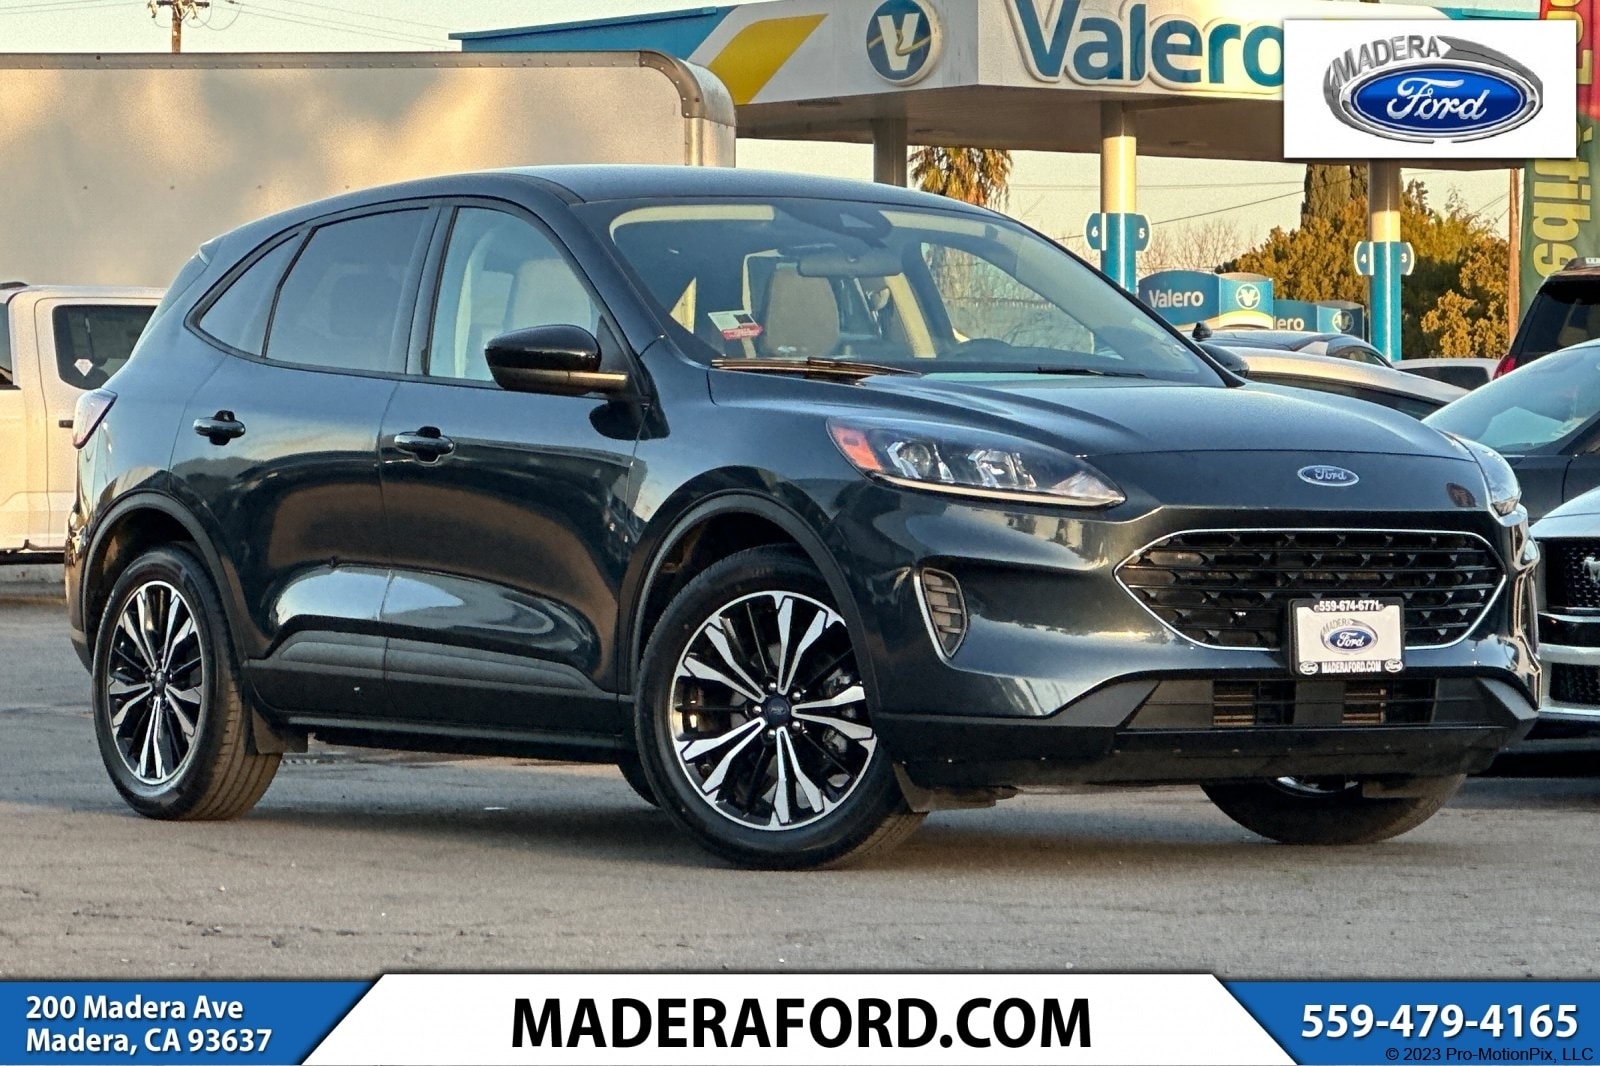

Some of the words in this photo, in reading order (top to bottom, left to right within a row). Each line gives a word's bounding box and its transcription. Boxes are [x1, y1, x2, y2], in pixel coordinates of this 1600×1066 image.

[1014, 0, 1285, 87] Valero
[1091, 226, 1099, 238] 6
[1138, 227, 1146, 239] 5
[1360, 253, 1367, 265] 4
[1400, 252, 1408, 263] 3
[1148, 288, 1204, 308] Valero
[1314, 468, 1347, 480] Ford
[1319, 600, 1380, 612] 559-674-6771
[1336, 631, 1365, 647] Ford
[1321, 660, 1382, 674] MADERAFORD.COM
